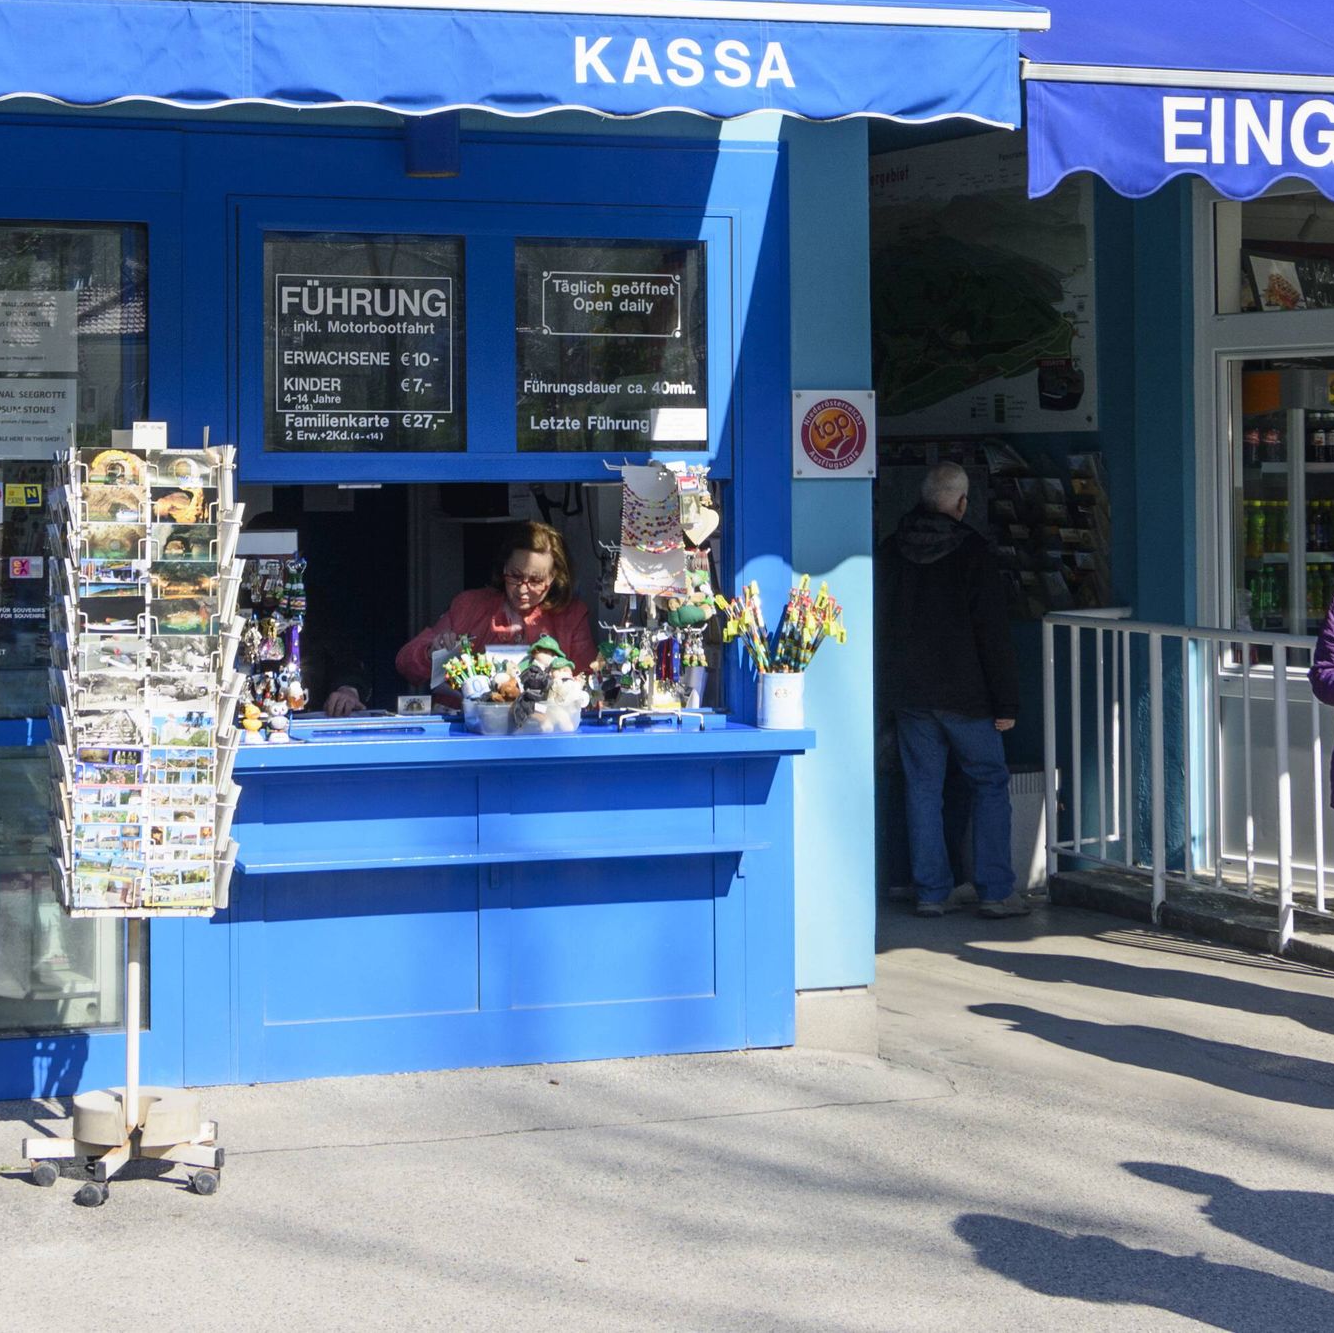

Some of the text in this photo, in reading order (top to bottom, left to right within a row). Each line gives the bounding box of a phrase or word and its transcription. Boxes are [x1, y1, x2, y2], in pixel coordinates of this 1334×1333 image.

[574, 34, 796, 89] KASSA
[552, 279, 675, 296] Täglich geöffnet
[282, 280, 447, 318] FÜHRUNG
[573, 298, 653, 314] Open daily
[294, 321, 435, 335] inkl. Motorbootfahrt
[284, 351, 390, 366] ERWACHSENE
[284, 378, 341, 391] KINDER
[524, 380, 622, 395] Führungsdauer
[627, 384, 646, 394] ca.
[19, 391, 67, 399] SEEGROTTE
[284, 394, 341, 404] 4-14 Jahre
[23, 406, 55, 414] STONES
[803, 399, 863, 427] Niederösterreichs
[285, 414, 389, 428] Familienkarte
[530, 416, 650, 433] Letzte Führung
[813, 413, 851, 440] top
[286, 431, 292, 440] 2
[808, 450, 860, 469] Ausflugsziele
